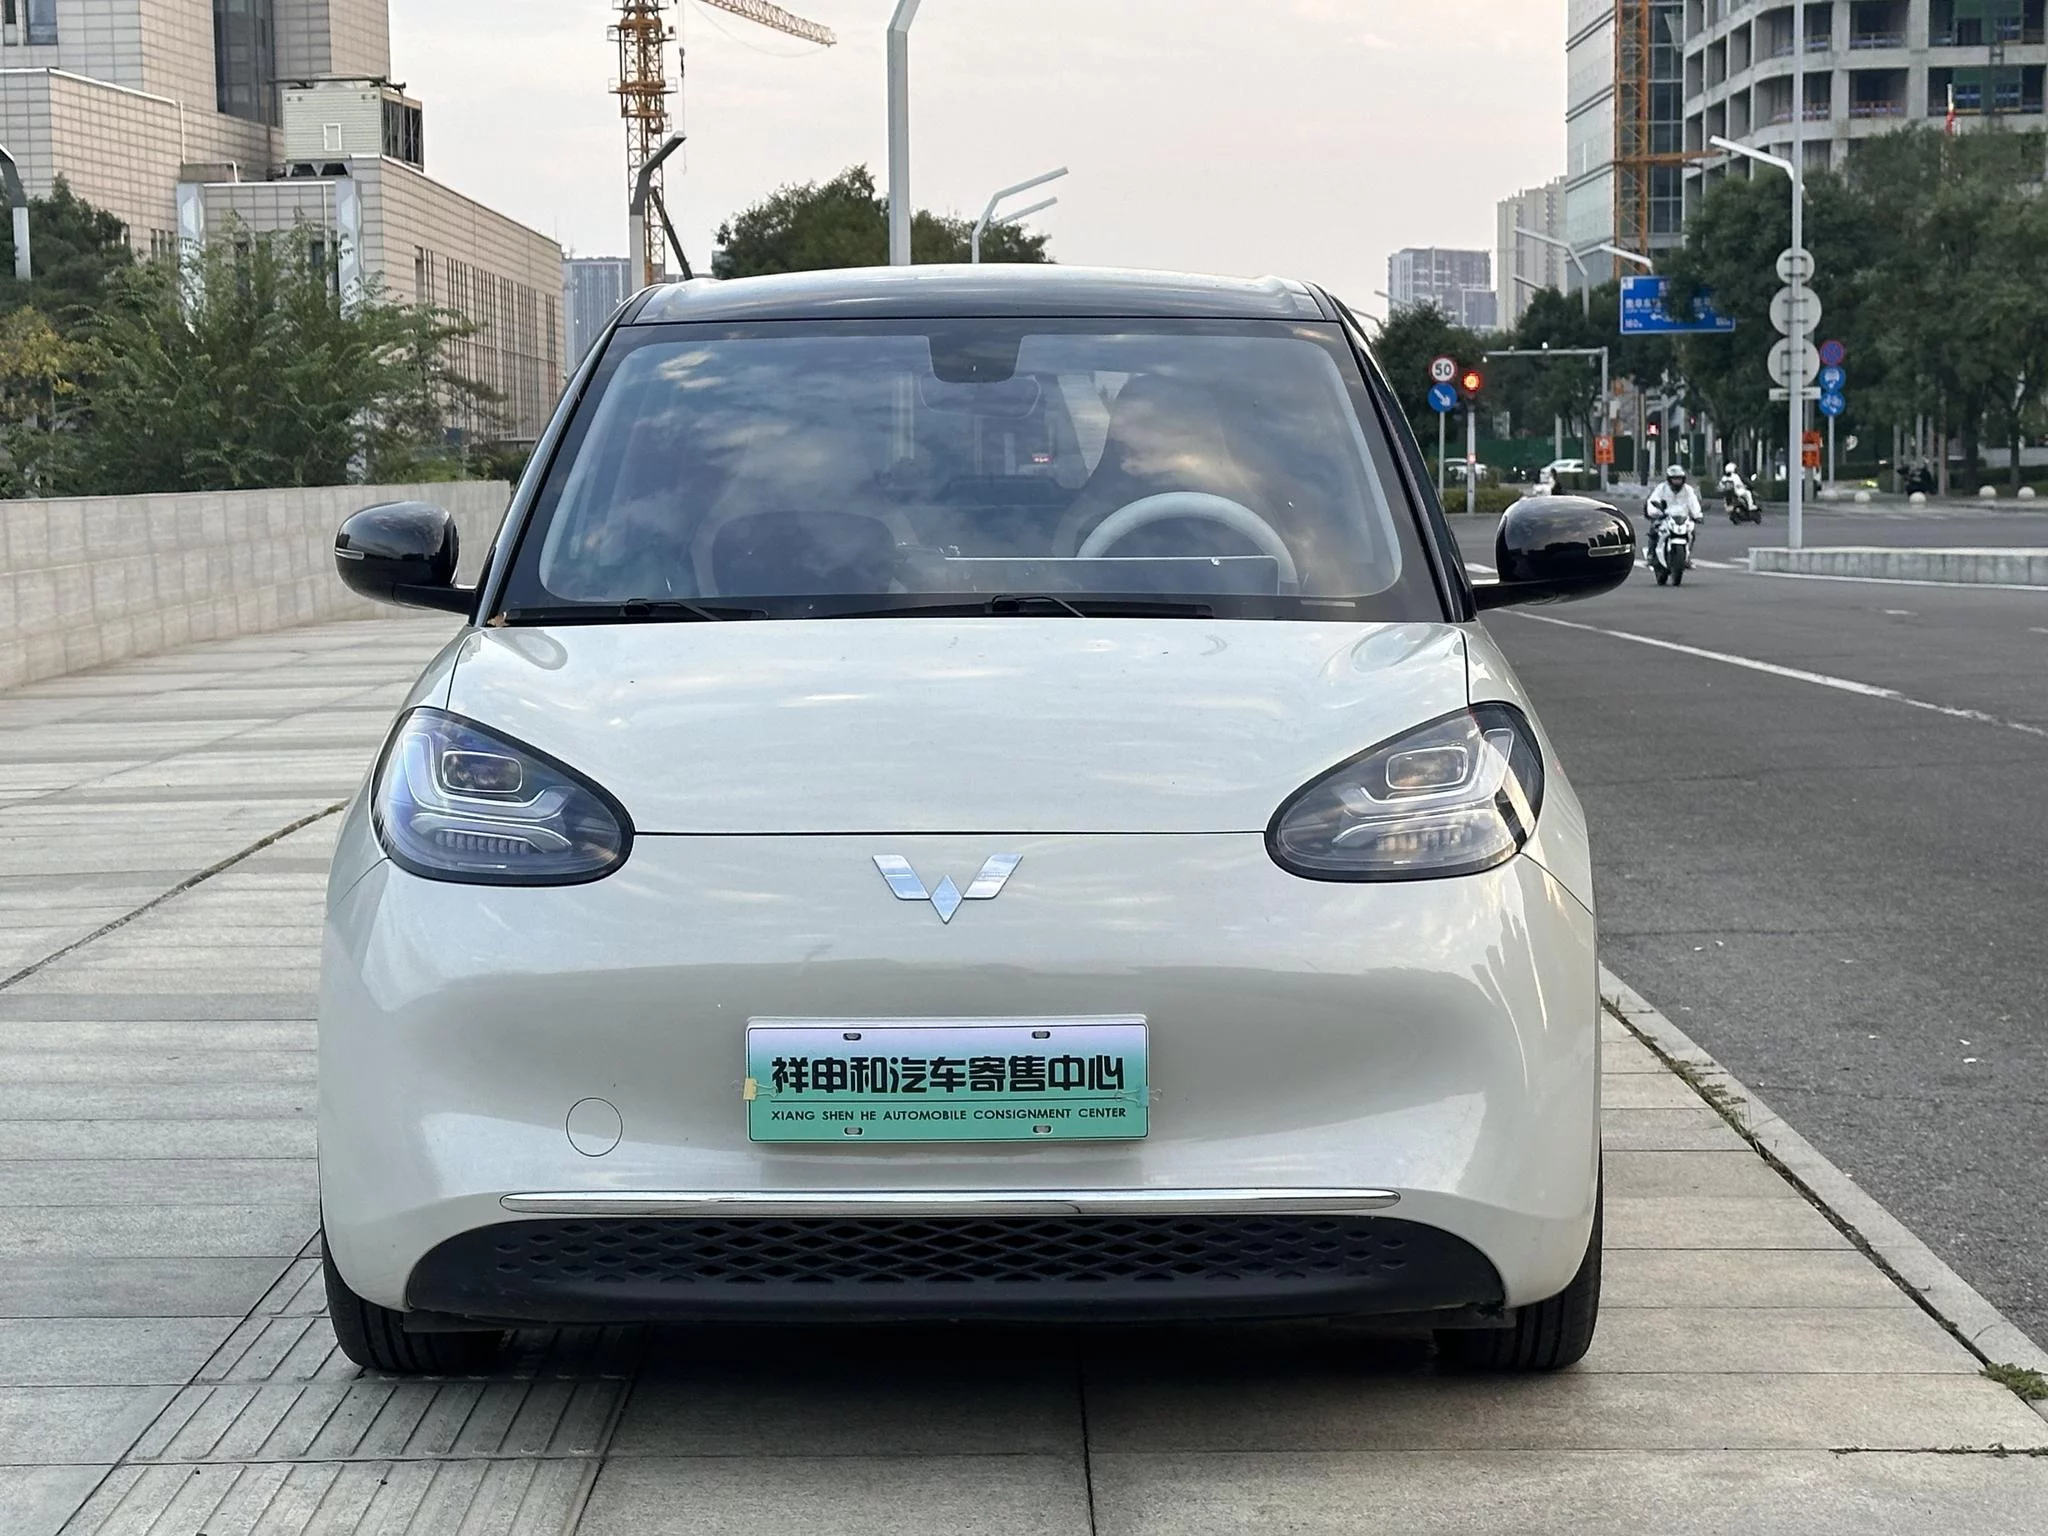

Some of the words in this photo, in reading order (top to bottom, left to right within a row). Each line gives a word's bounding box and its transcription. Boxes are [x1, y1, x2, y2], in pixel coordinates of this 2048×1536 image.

[1435, 364, 1452, 376] 50
[772, 1055, 1124, 1093] 祥申和汽车寄售中心
[771, 1111, 815, 1121] XIANG
[822, 1110, 854, 1121] SHEN
[860, 1110, 877, 1121] HE
[883, 1109, 967, 1121] AUTOMOBILE
[973, 1108, 1072, 1120] CONSIGNMENT
[1078, 1107, 1127, 1118] CENTER
